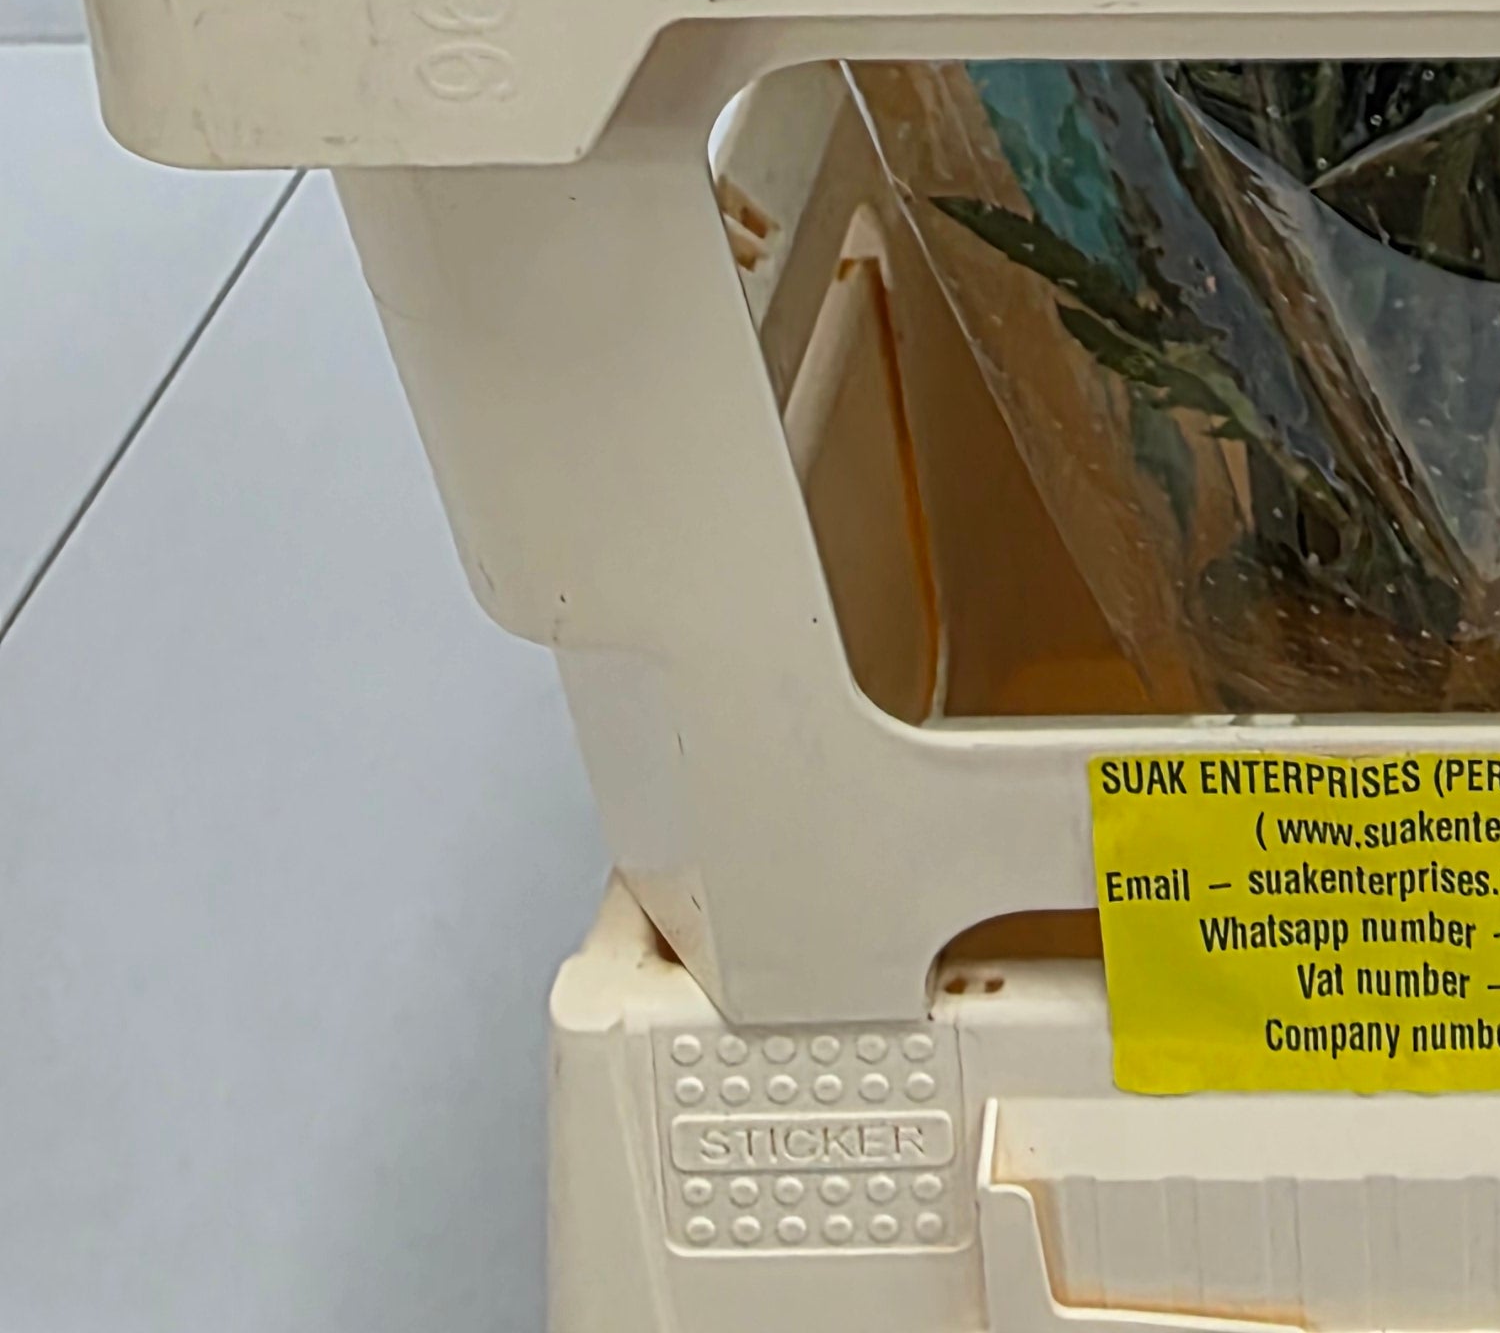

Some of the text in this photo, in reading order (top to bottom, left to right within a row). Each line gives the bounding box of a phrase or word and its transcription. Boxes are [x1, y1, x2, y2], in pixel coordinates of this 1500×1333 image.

[1101, 759, 1187, 795] SUAK
[1200, 756, 1420, 799] ENTERPRISES
[1106, 868, 1190, 902] Email
[1199, 914, 1349, 953] Whatsapp
[1362, 910, 1476, 949] number
[1297, 962, 1344, 999] Vat
[1357, 961, 1470, 999] number
[1265, 1018, 1400, 1060] Company
[699, 1124, 927, 1165] STICKER
